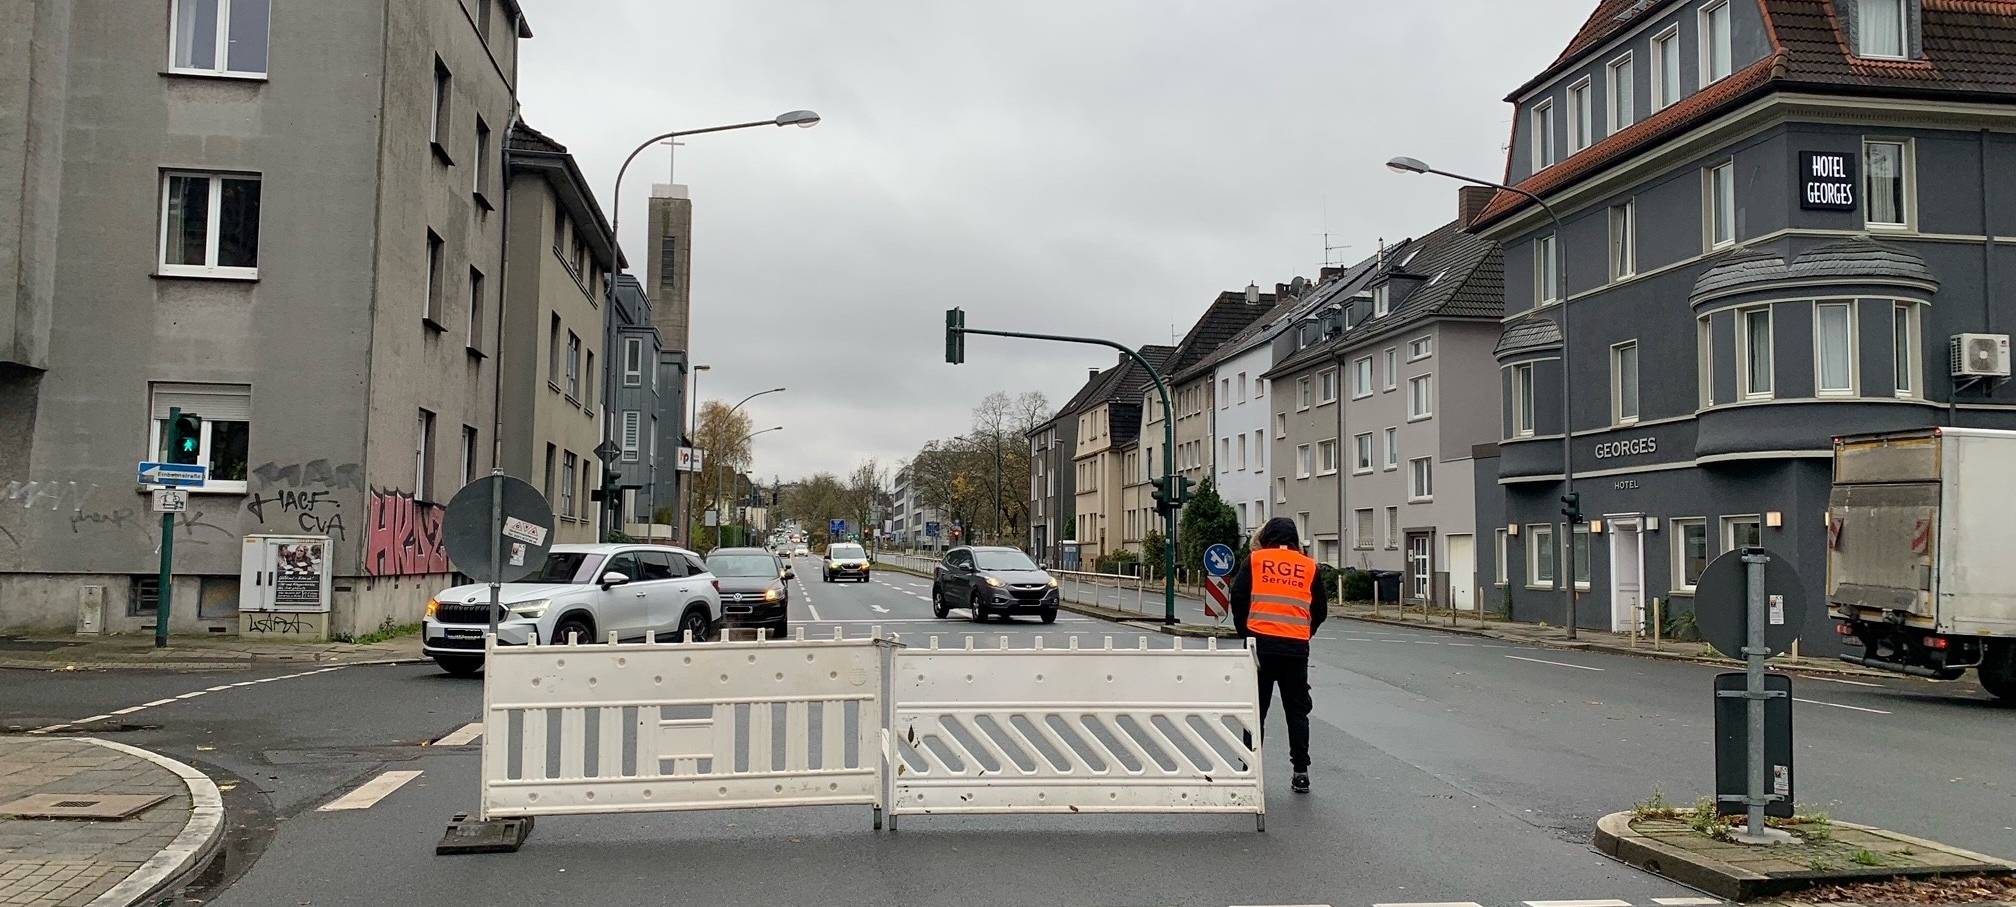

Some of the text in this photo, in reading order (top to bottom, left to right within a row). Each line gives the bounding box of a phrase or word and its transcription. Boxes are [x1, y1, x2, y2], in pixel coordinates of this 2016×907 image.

[1812, 155, 1846, 178] HOTEL
[1807, 181, 1853, 205] GEORGES
[1595, 437, 1656, 458] GEORGES
[158, 471, 201, 479] Einbahnstraße
[1614, 480, 1639, 490] HOTEL
[1262, 560, 1305, 579] RGE
[1262, 575, 1304, 588] Service
